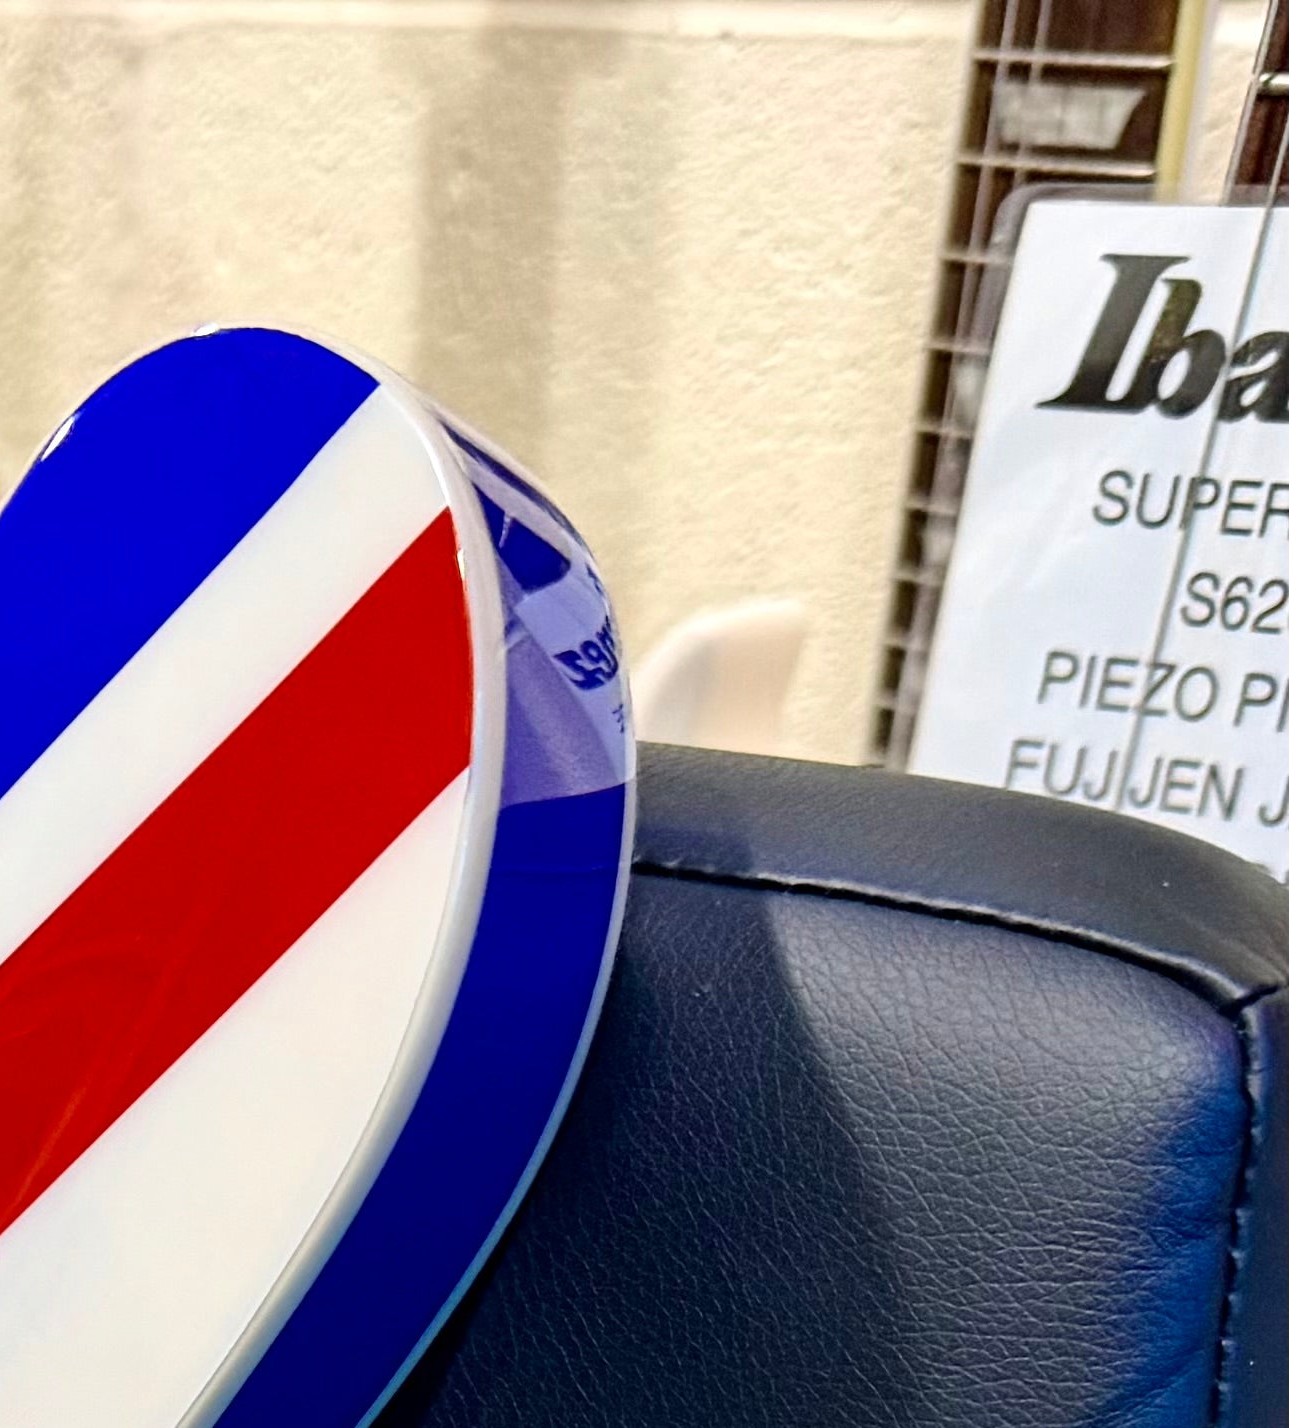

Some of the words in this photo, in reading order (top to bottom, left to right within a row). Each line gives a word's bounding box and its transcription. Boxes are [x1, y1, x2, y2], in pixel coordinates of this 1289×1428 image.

[1034, 253, 1289, 423] Iba
[1180, 571, 1289, 635] S62
[1037, 650, 1220, 722] PIEZO
